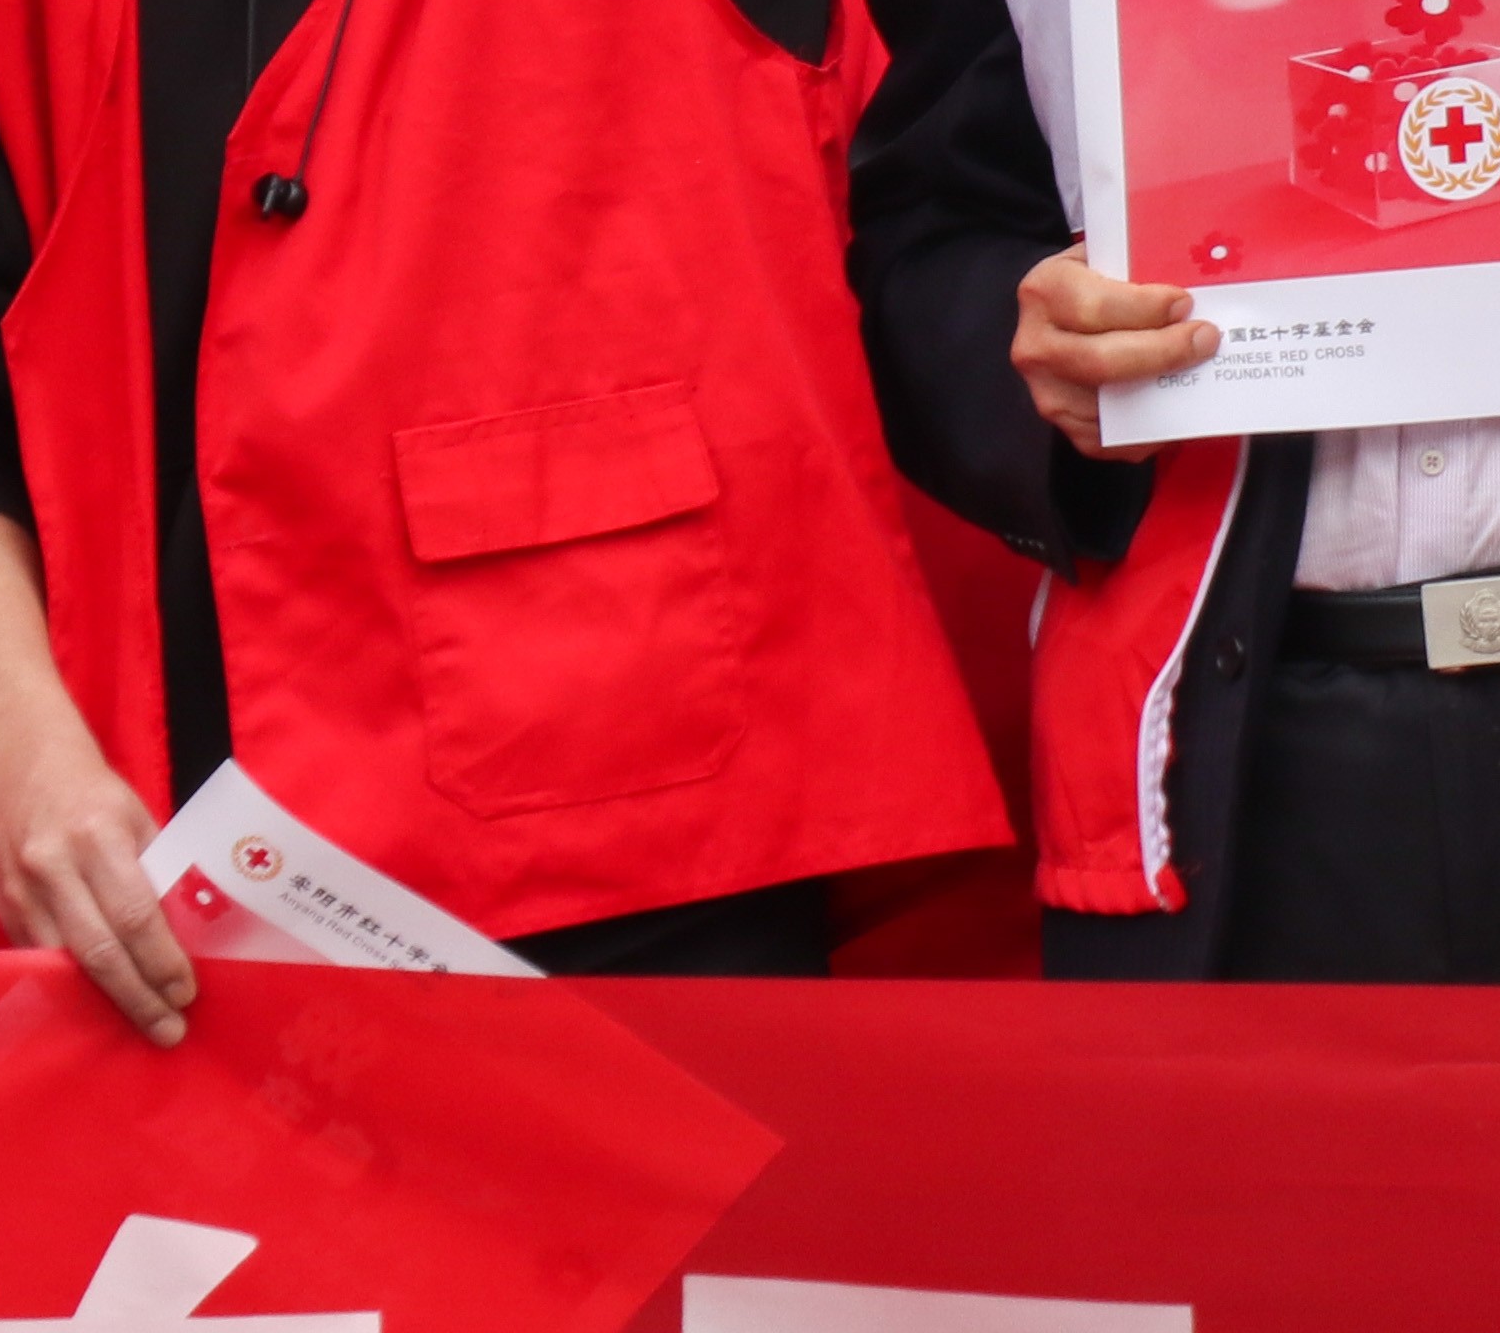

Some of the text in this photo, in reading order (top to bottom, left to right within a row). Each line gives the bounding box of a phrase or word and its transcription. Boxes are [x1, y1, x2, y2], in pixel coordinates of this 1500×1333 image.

[1222, 318, 1376, 343] 国红十字基金会
[1213, 345, 1365, 366] CHINESE RED CROSS
[1158, 374, 1201, 389] CRCF
[1215, 366, 1304, 381] FOUNDATION
[279, 892, 324, 924] Anyang
[326, 919, 350, 940] Red
